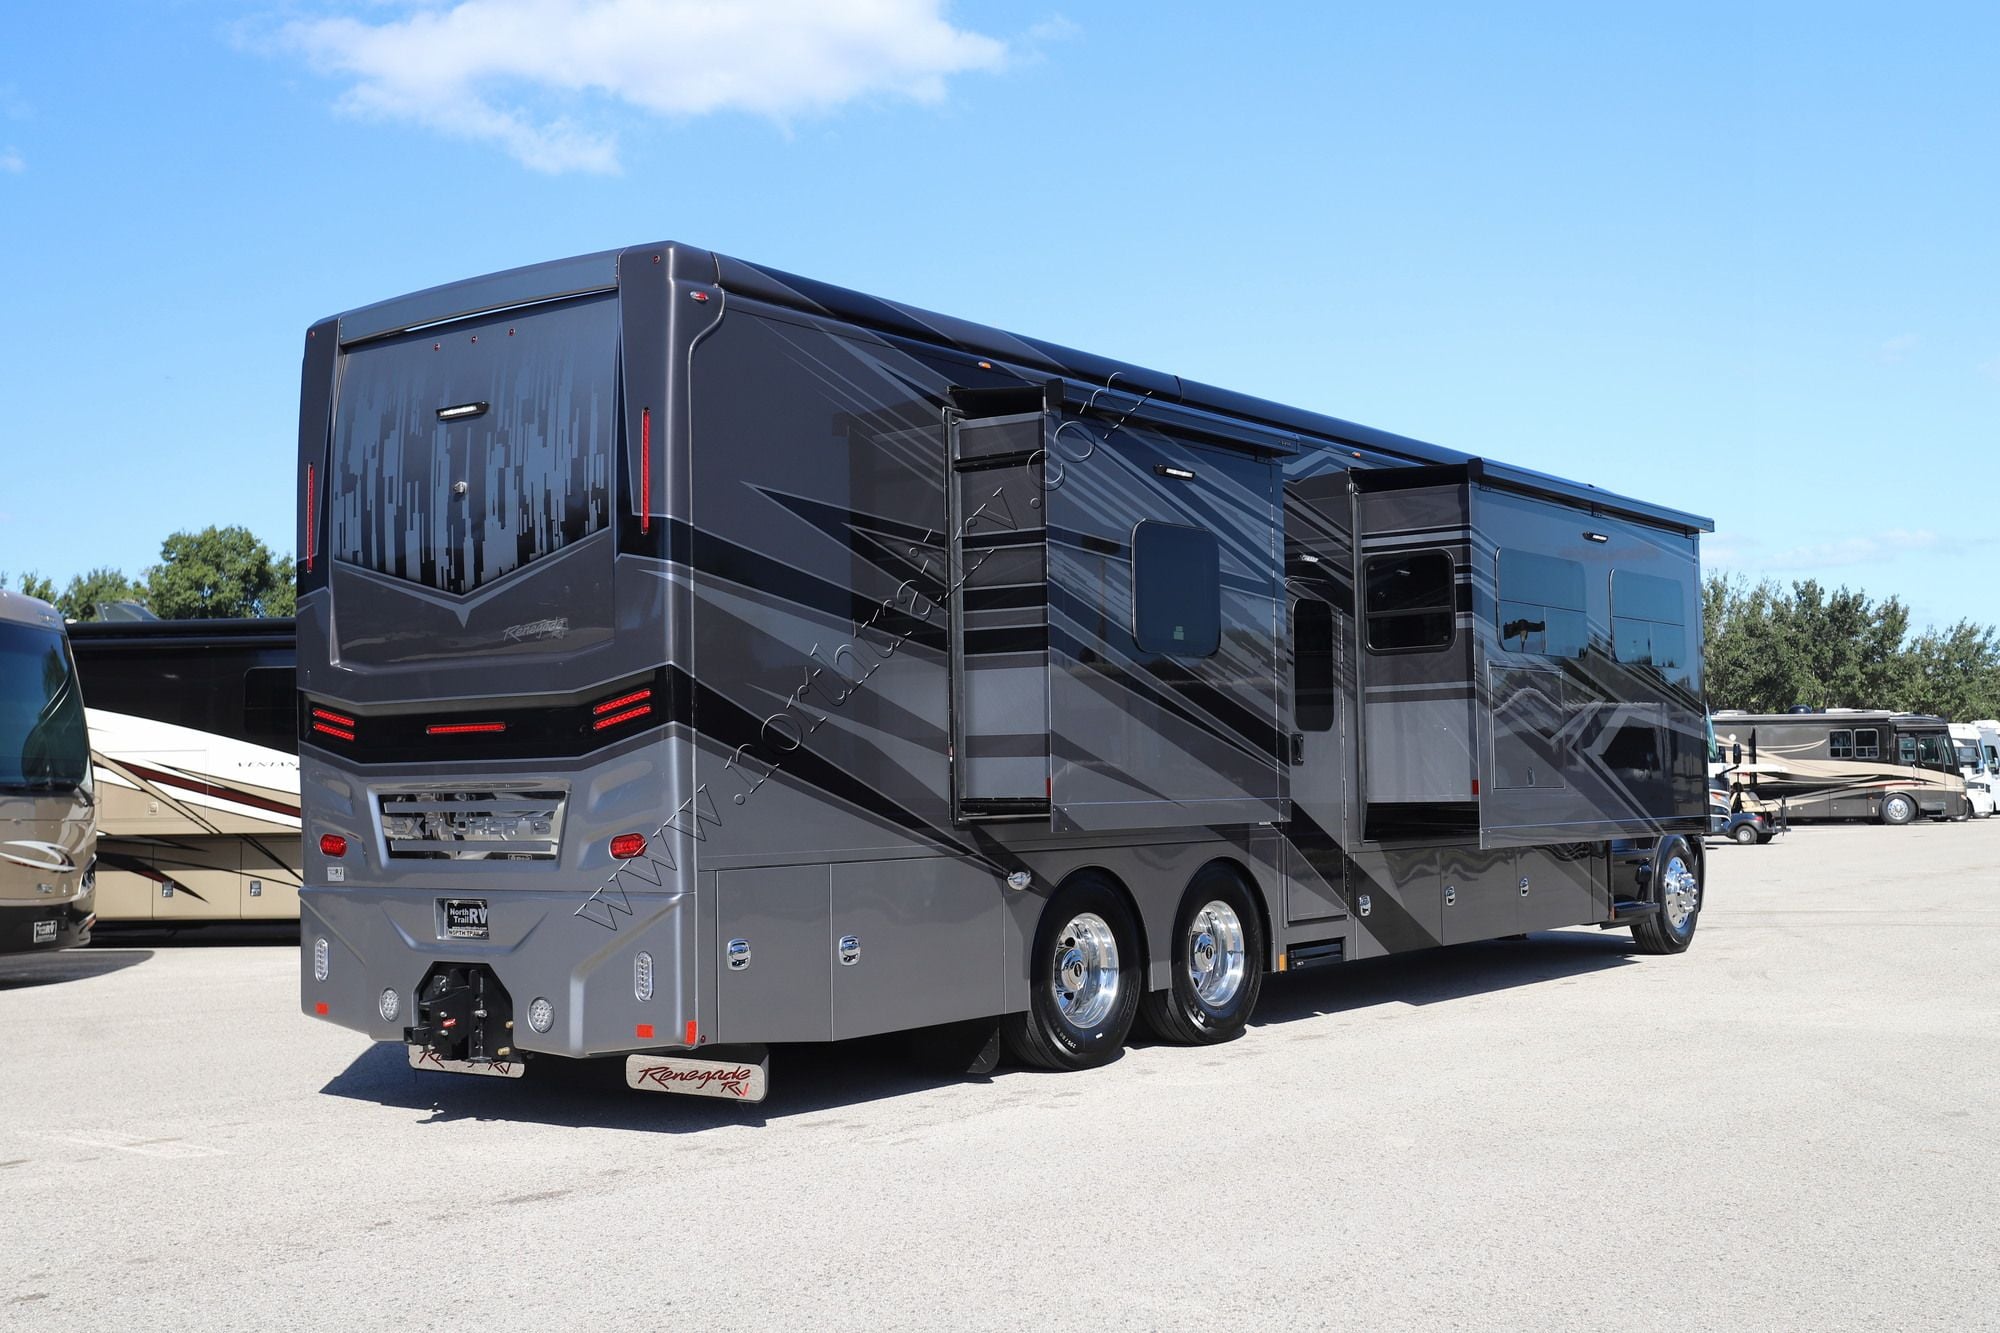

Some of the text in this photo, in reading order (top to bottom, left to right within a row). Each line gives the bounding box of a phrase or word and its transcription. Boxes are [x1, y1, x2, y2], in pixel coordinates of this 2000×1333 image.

[450, 907, 469, 916] North
[453, 916, 469, 924] Trail
[469, 907, 488, 924] RV
[638, 1066, 751, 1090] Renegade
[721, 1080, 749, 1097] RV
